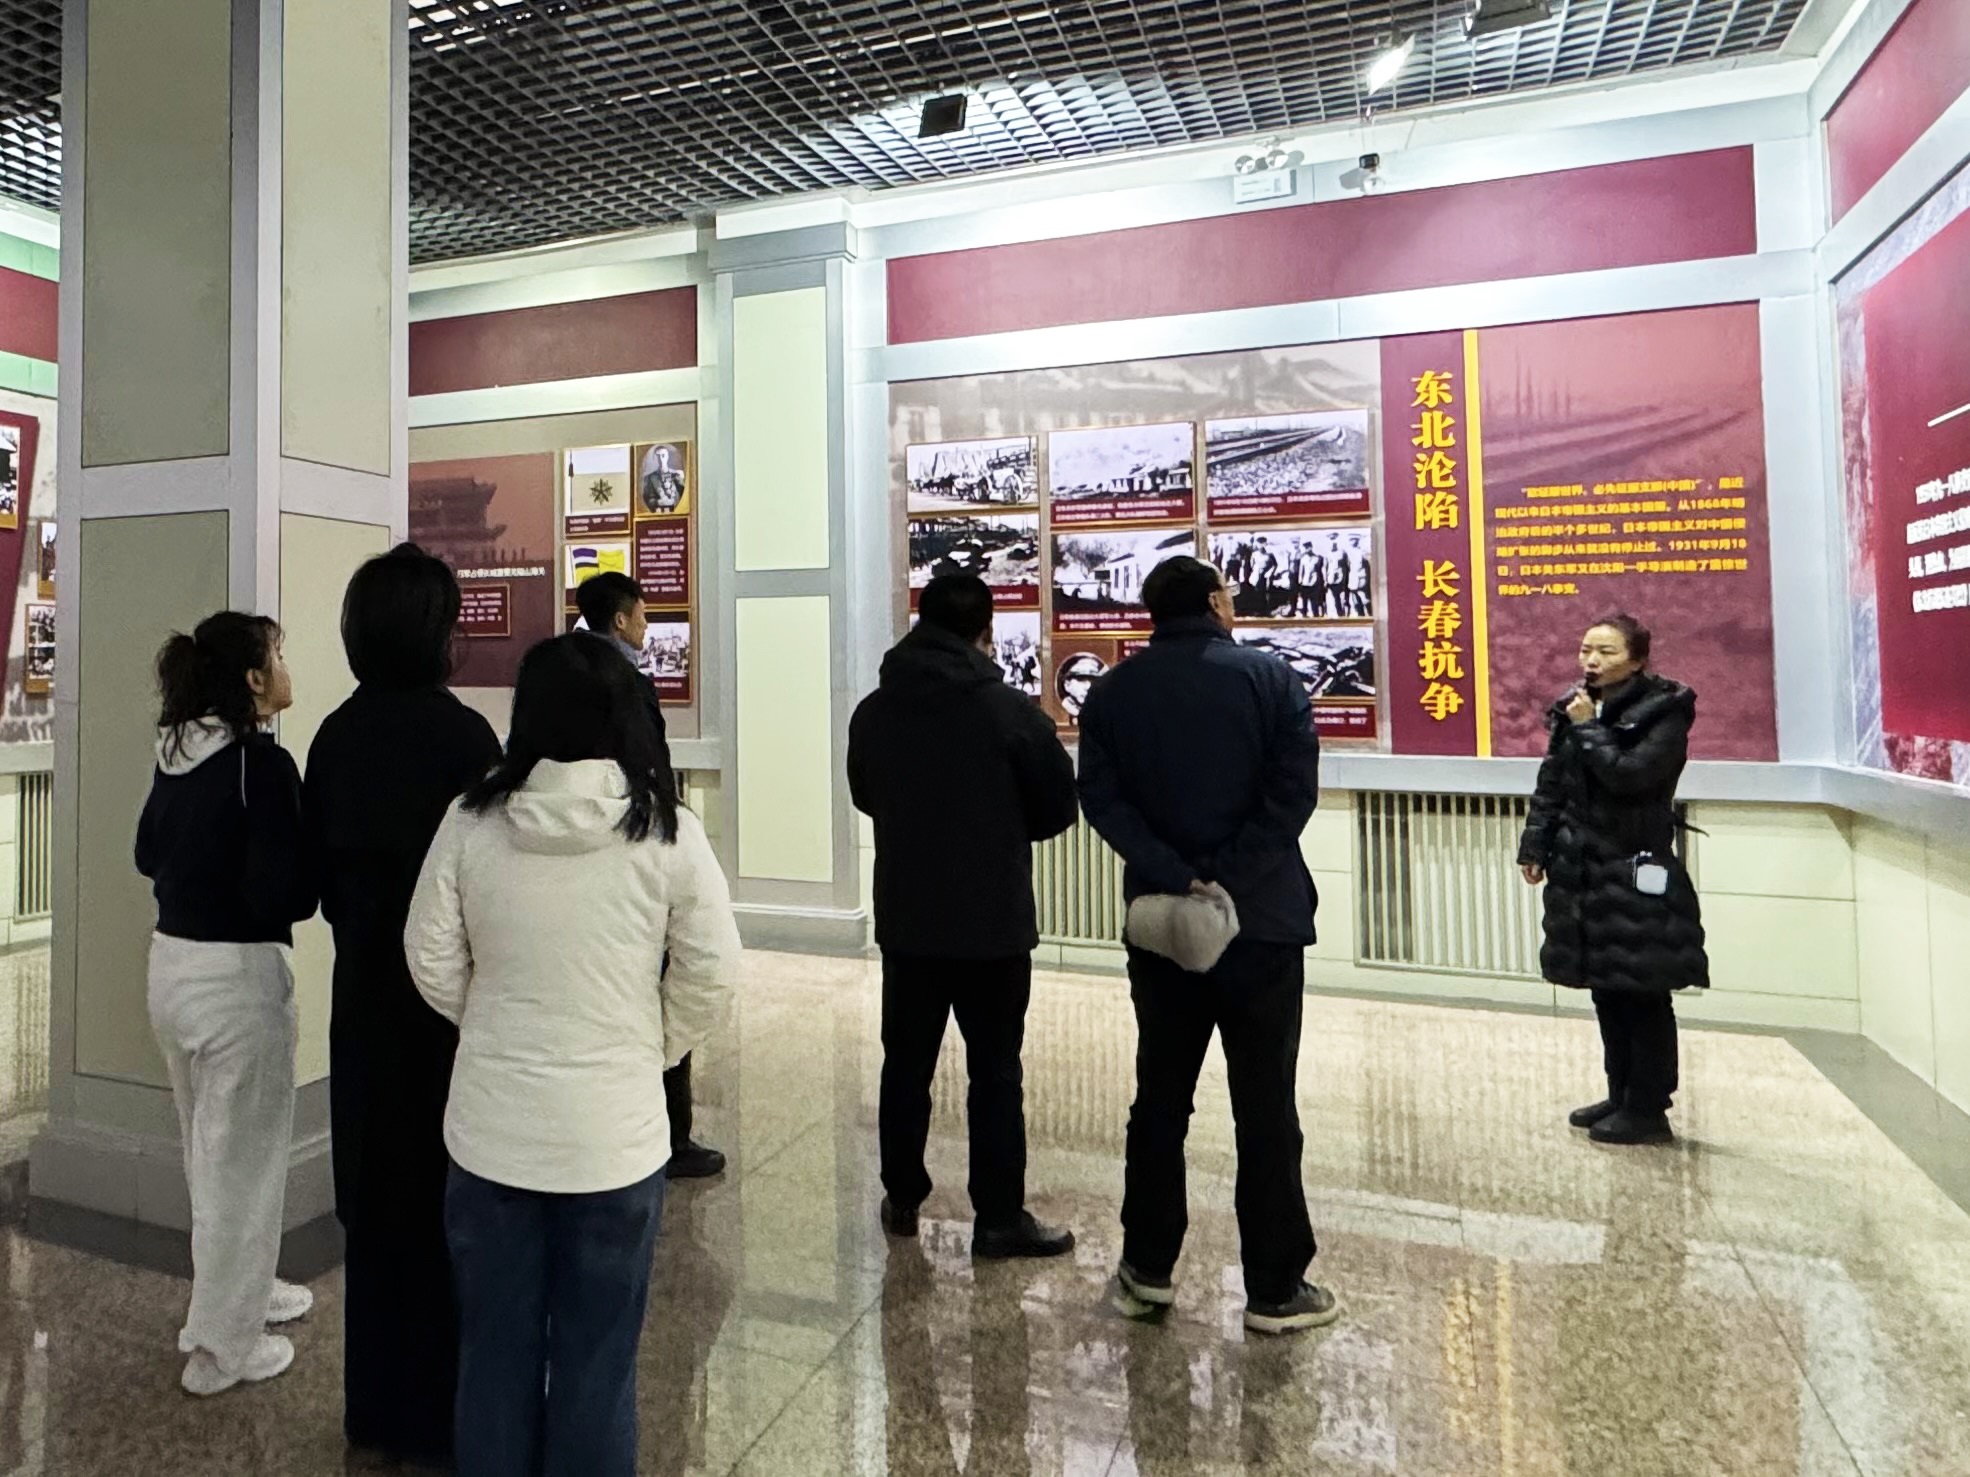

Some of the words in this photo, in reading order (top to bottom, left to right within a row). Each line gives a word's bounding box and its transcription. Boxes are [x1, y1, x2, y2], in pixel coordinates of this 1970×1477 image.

[1411, 370, 1460, 530] 东北沦陷
[1416, 560, 1465, 721] 长春抗争
